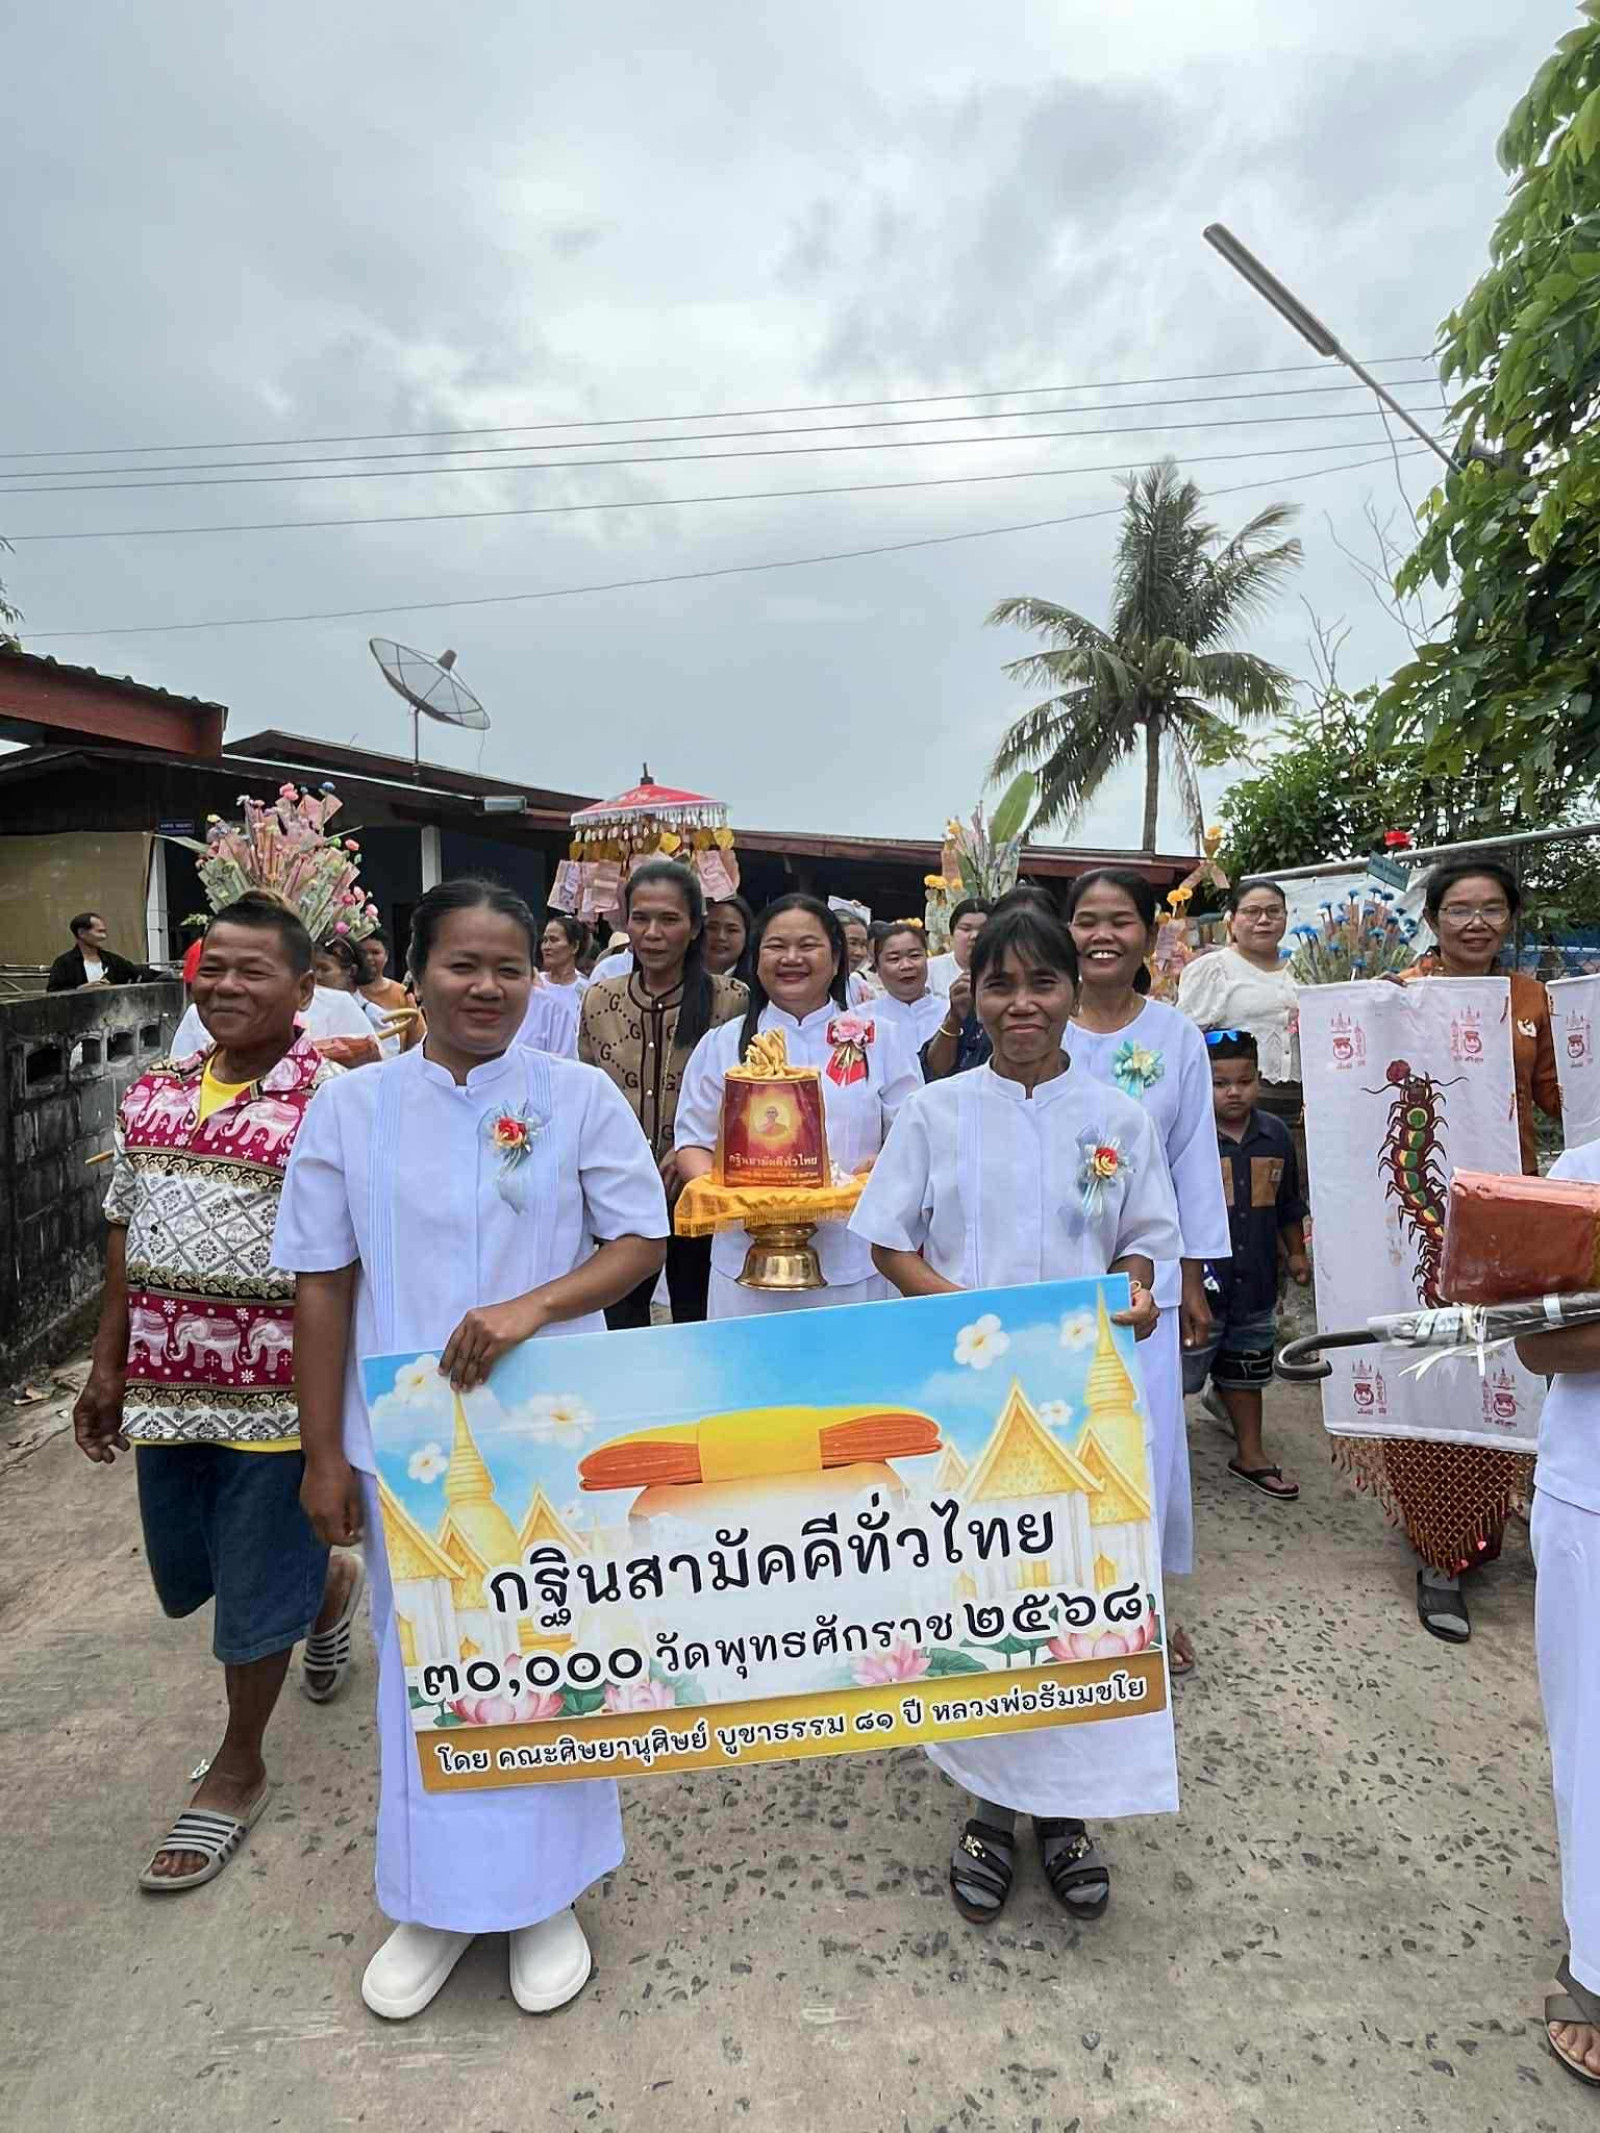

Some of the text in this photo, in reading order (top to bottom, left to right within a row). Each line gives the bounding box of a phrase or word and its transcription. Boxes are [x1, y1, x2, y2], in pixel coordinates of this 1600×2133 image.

[625, 1072, 638, 1089] G
[490, 1491, 1054, 1628] กฐินสามัคคีทั่วไทย
[423, 1582, 1142, 1697] ๓๐,๐๐๐ วัดพุทธศักราช ๒๕๖๘
[438, 1673, 1145, 1771] โดย คณะศิษยานุศิษย์ บูชาธรรม ๘๑ ปี หลวงพ่อธัมมชโย
